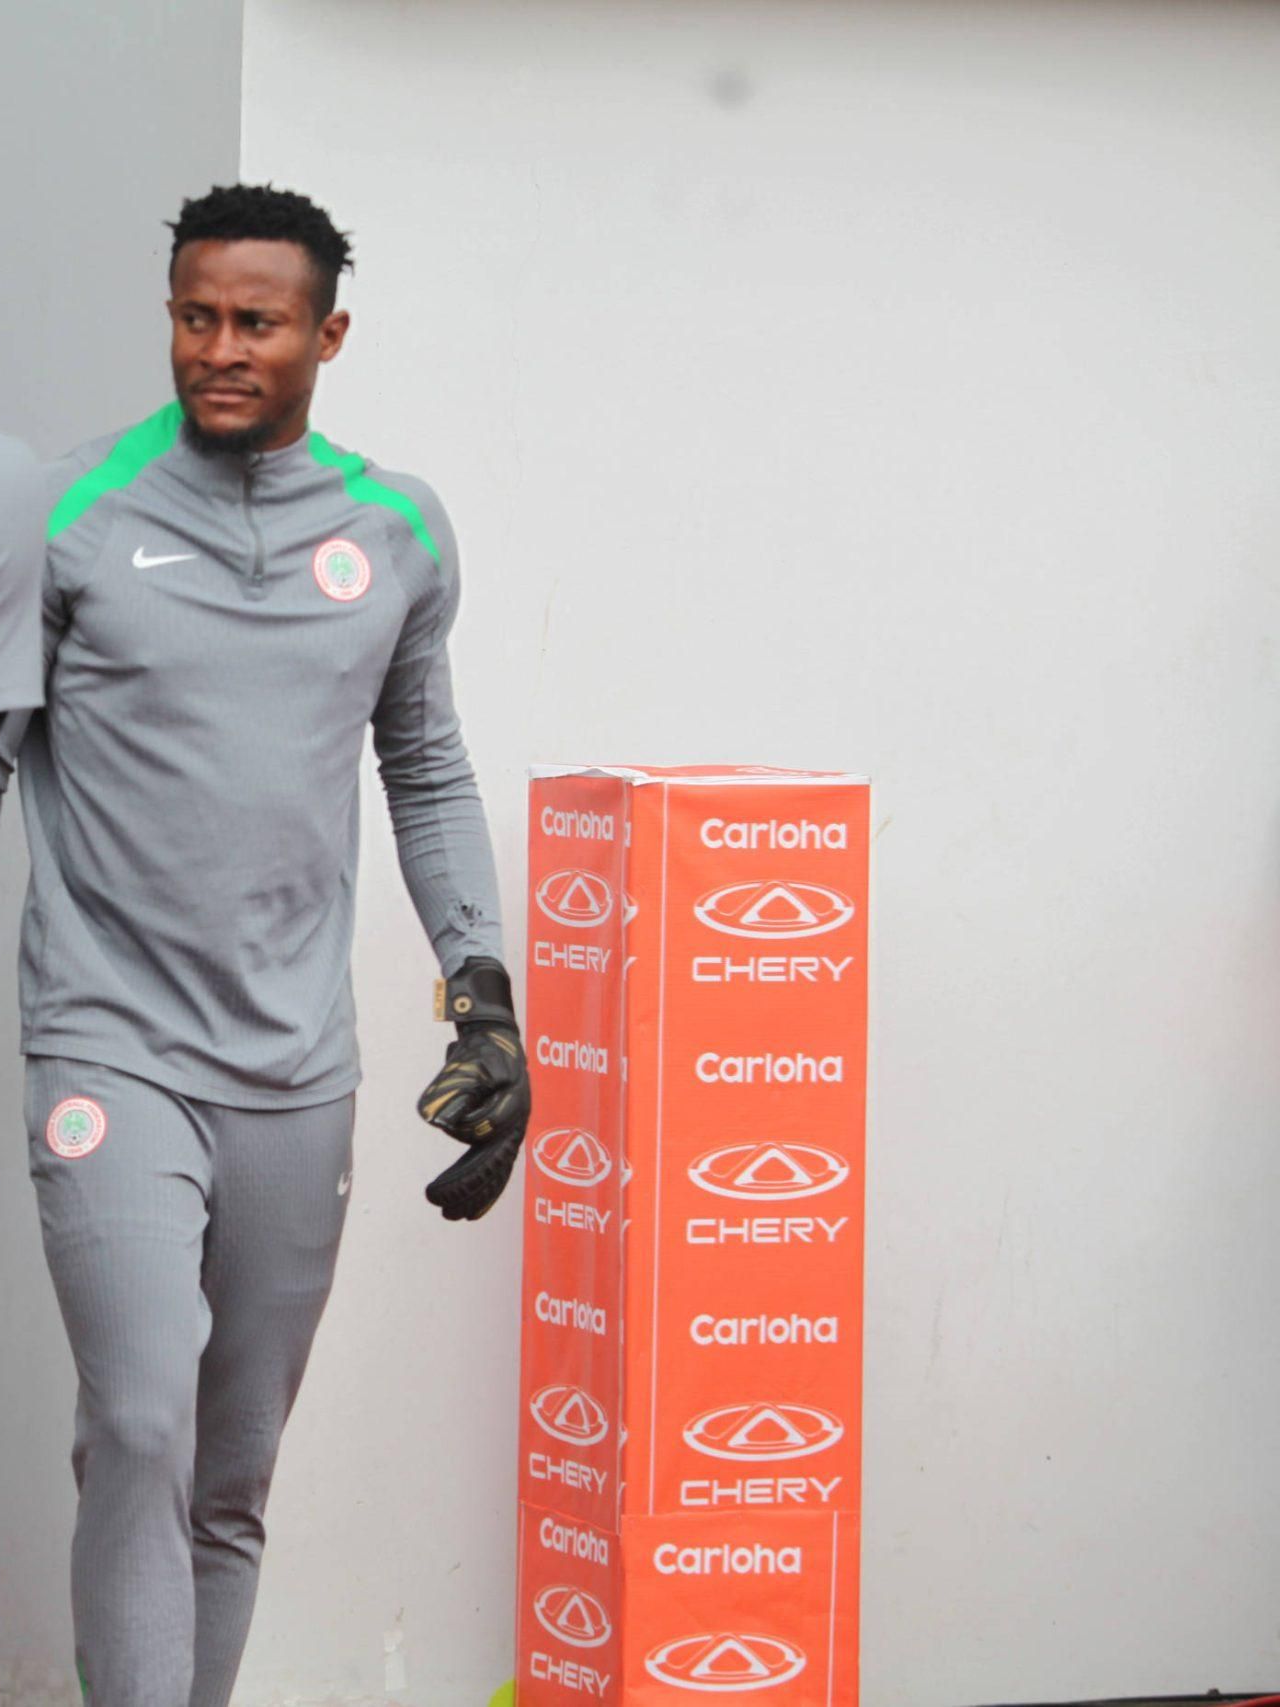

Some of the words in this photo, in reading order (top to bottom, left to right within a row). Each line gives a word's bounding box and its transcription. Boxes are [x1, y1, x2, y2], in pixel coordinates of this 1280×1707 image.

[541, 806, 614, 841] Carloha
[700, 818, 847, 849] Carloha
[534, 941, 612, 974] CHERY
[692, 956, 854, 982] CHERY
[536, 1035, 608, 1074] Carloha
[695, 1053, 843, 1083] Carloha
[534, 1197, 612, 1234] CHERY
[687, 1217, 849, 1245] CHERY
[535, 1291, 606, 1335] Carloha
[690, 1314, 838, 1345] Carloha
[529, 1452, 608, 1494] CHERY
[680, 1477, 842, 1506] CHERY
[540, 1518, 608, 1566] Carloha
[653, 1544, 802, 1574] Carloha
[530, 1651, 610, 1697] CHERY
